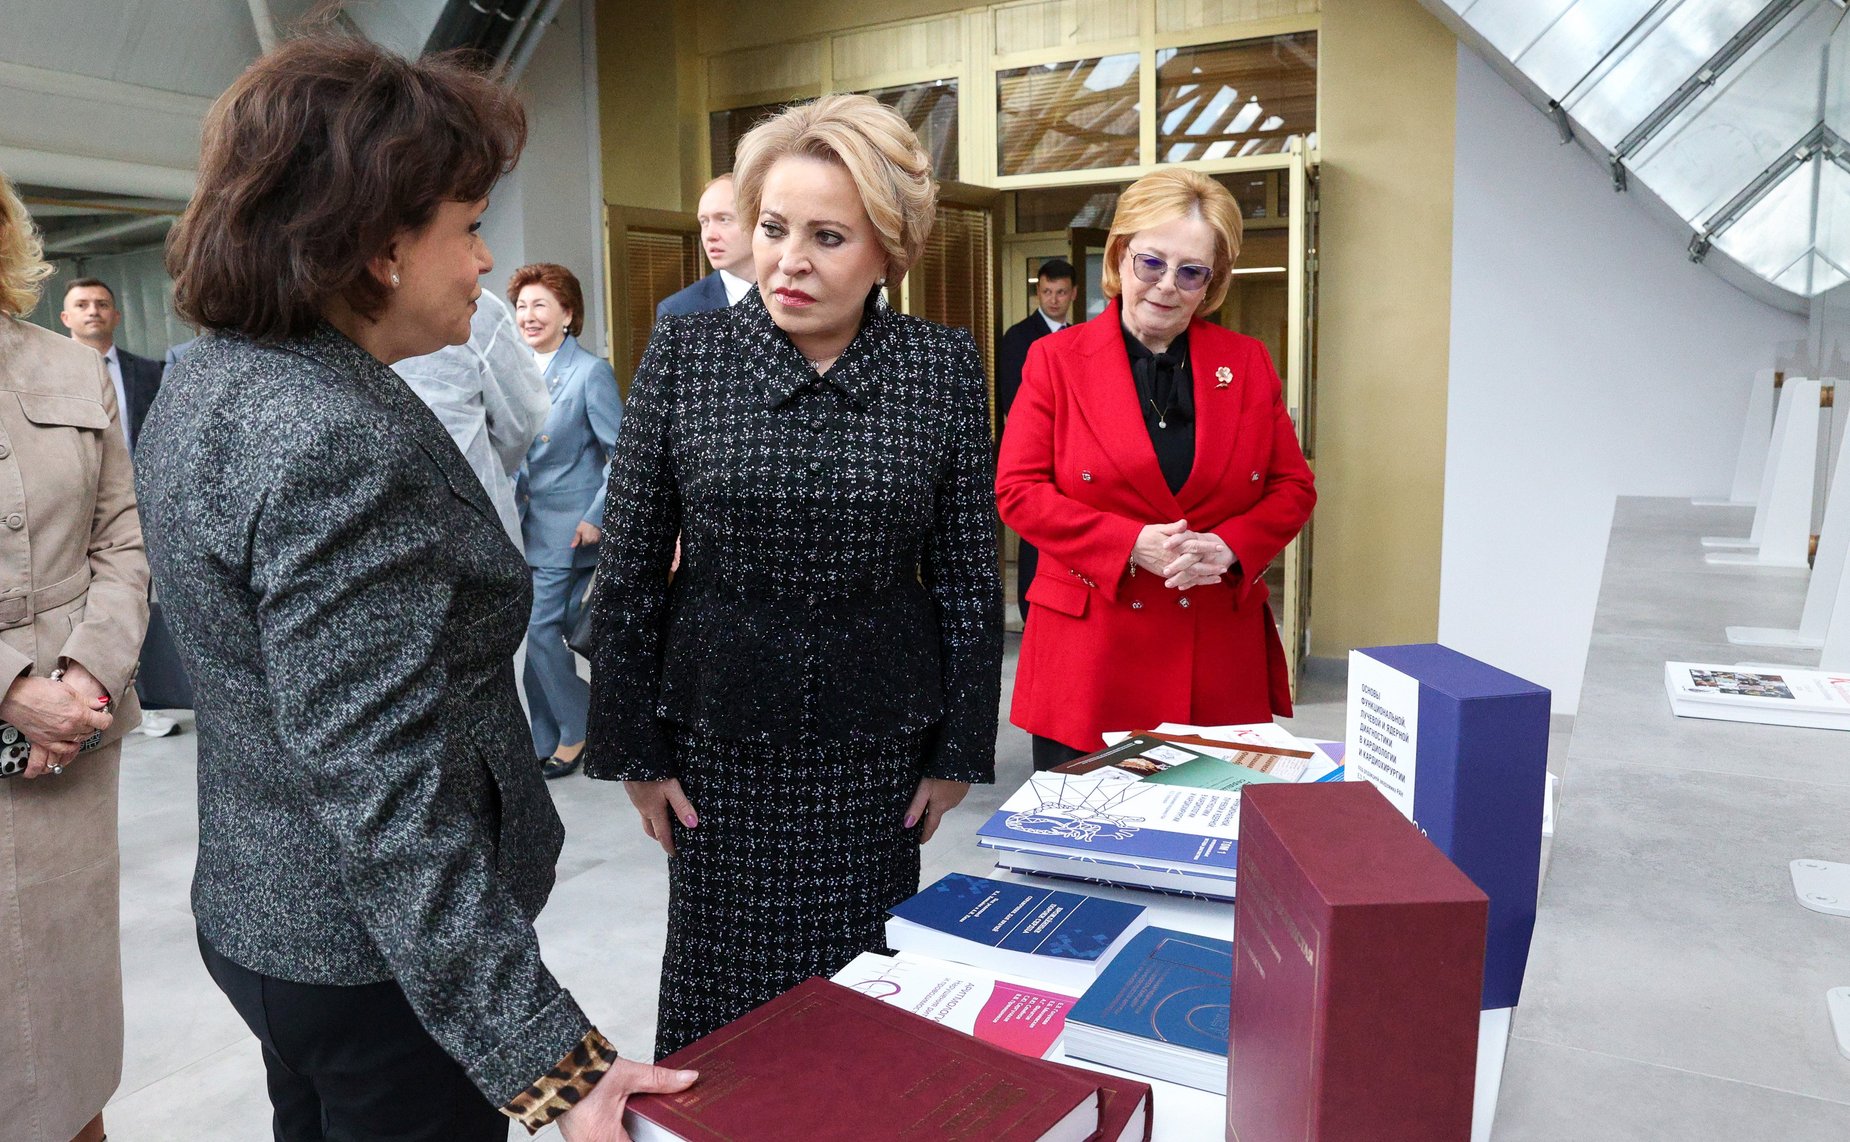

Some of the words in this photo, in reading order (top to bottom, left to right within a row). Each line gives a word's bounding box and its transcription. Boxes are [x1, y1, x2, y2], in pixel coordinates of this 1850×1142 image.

[1362, 684, 1380, 700] ОСНОВЫ
[1360, 709, 1381, 728] ЛУЧЕВОЙ
[1386, 724, 1410, 744] ЯДЕРНОЙ
[1360, 722, 1393, 748] ДИАГНОСТИКИ
[1363, 737, 1397, 764] КАРДИОЛОГИИ
[1363, 751, 1406, 783] КАРДИОХИРУРГИИ
[1218, 840, 1233, 852] ТОМ
[1022, 918, 1042, 934] СЕРДЦА
[934, 982, 975, 1022] АРИТМОЛОГИ
